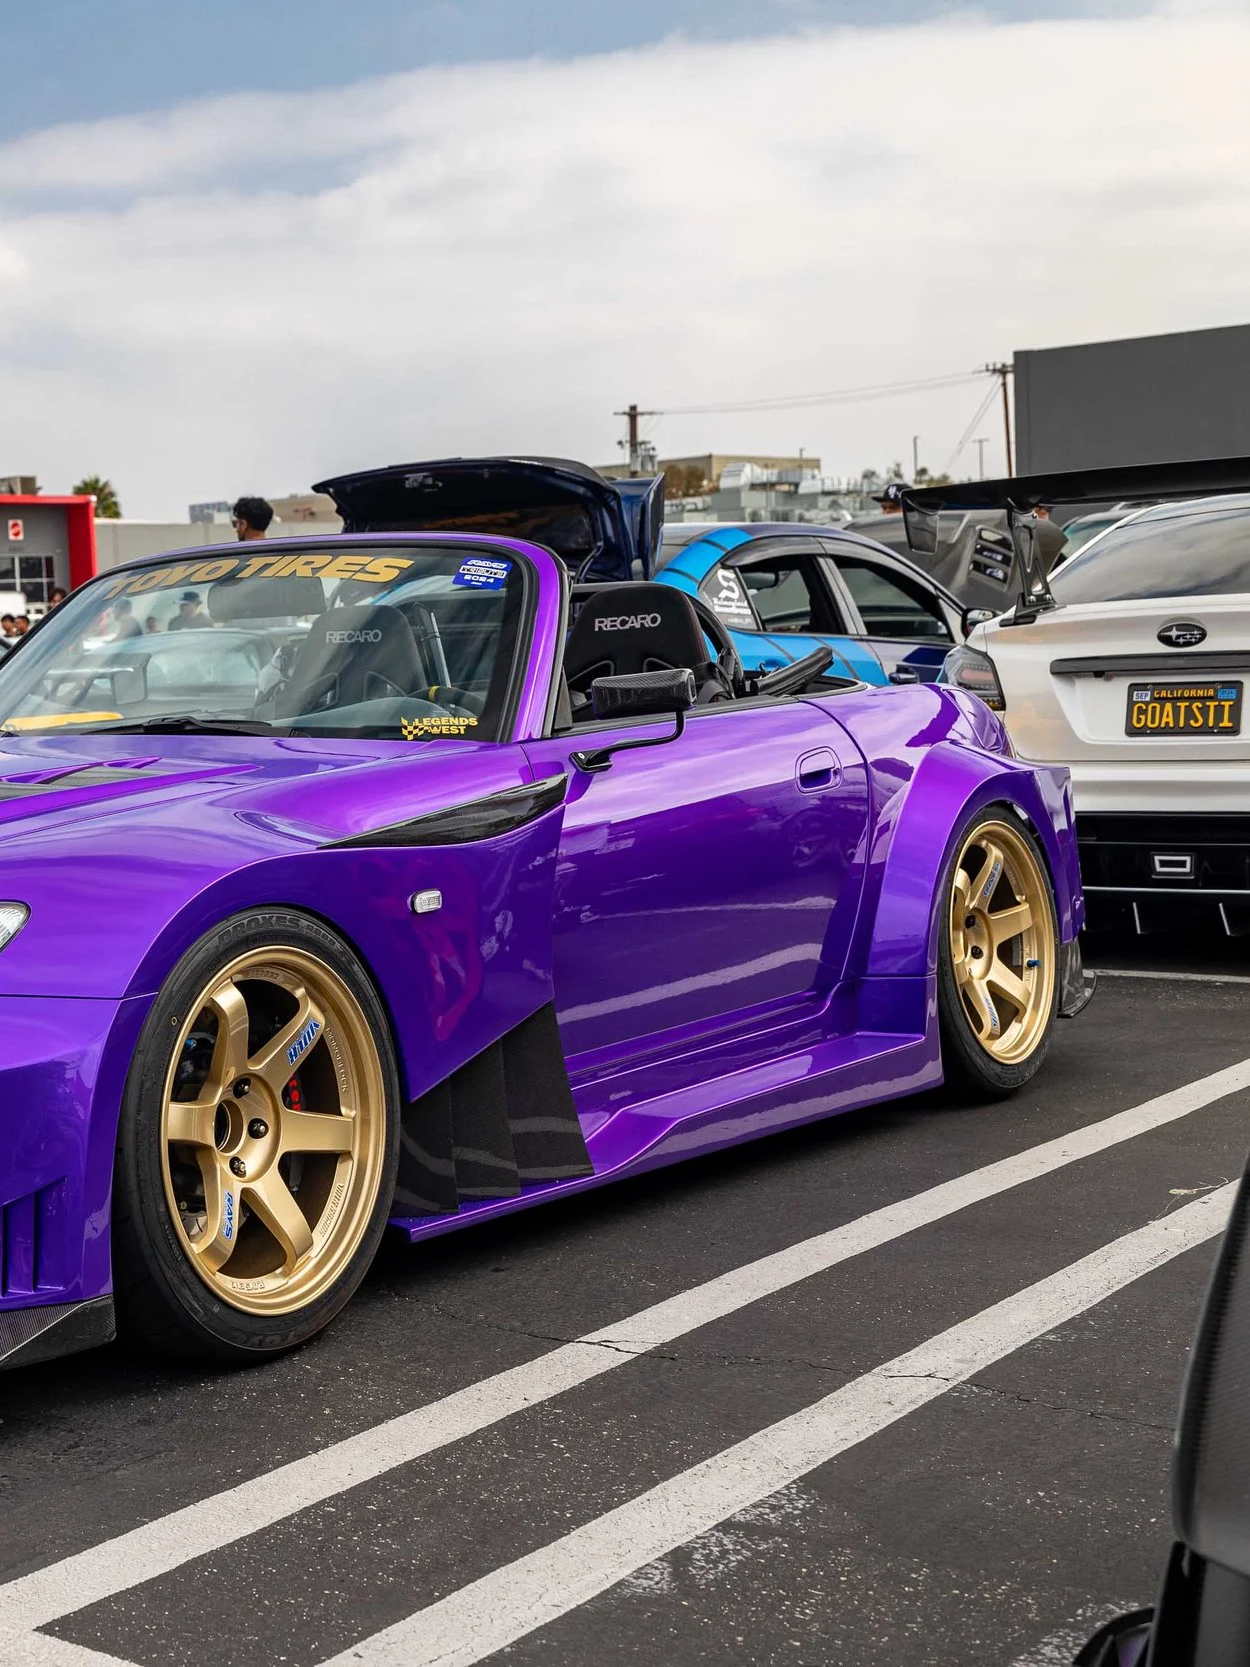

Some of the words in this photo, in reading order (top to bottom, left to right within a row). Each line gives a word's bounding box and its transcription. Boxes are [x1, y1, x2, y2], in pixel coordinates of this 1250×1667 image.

[104, 559, 239, 600] TOYO
[236, 555, 415, 583] TIRES
[463, 574, 495, 583] 2024
[594, 612, 662, 632] RECARO
[325, 629, 383, 644] RECARO
[1135, 692, 1149, 700] SEP
[1153, 688, 1215, 698] CALIFORNIA
[414, 717, 479, 726] LEGENDS
[1132, 701, 1234, 728] GOATSTI
[218, 914, 301, 946] PROXES
[223, 1190, 235, 1241] RAYS
